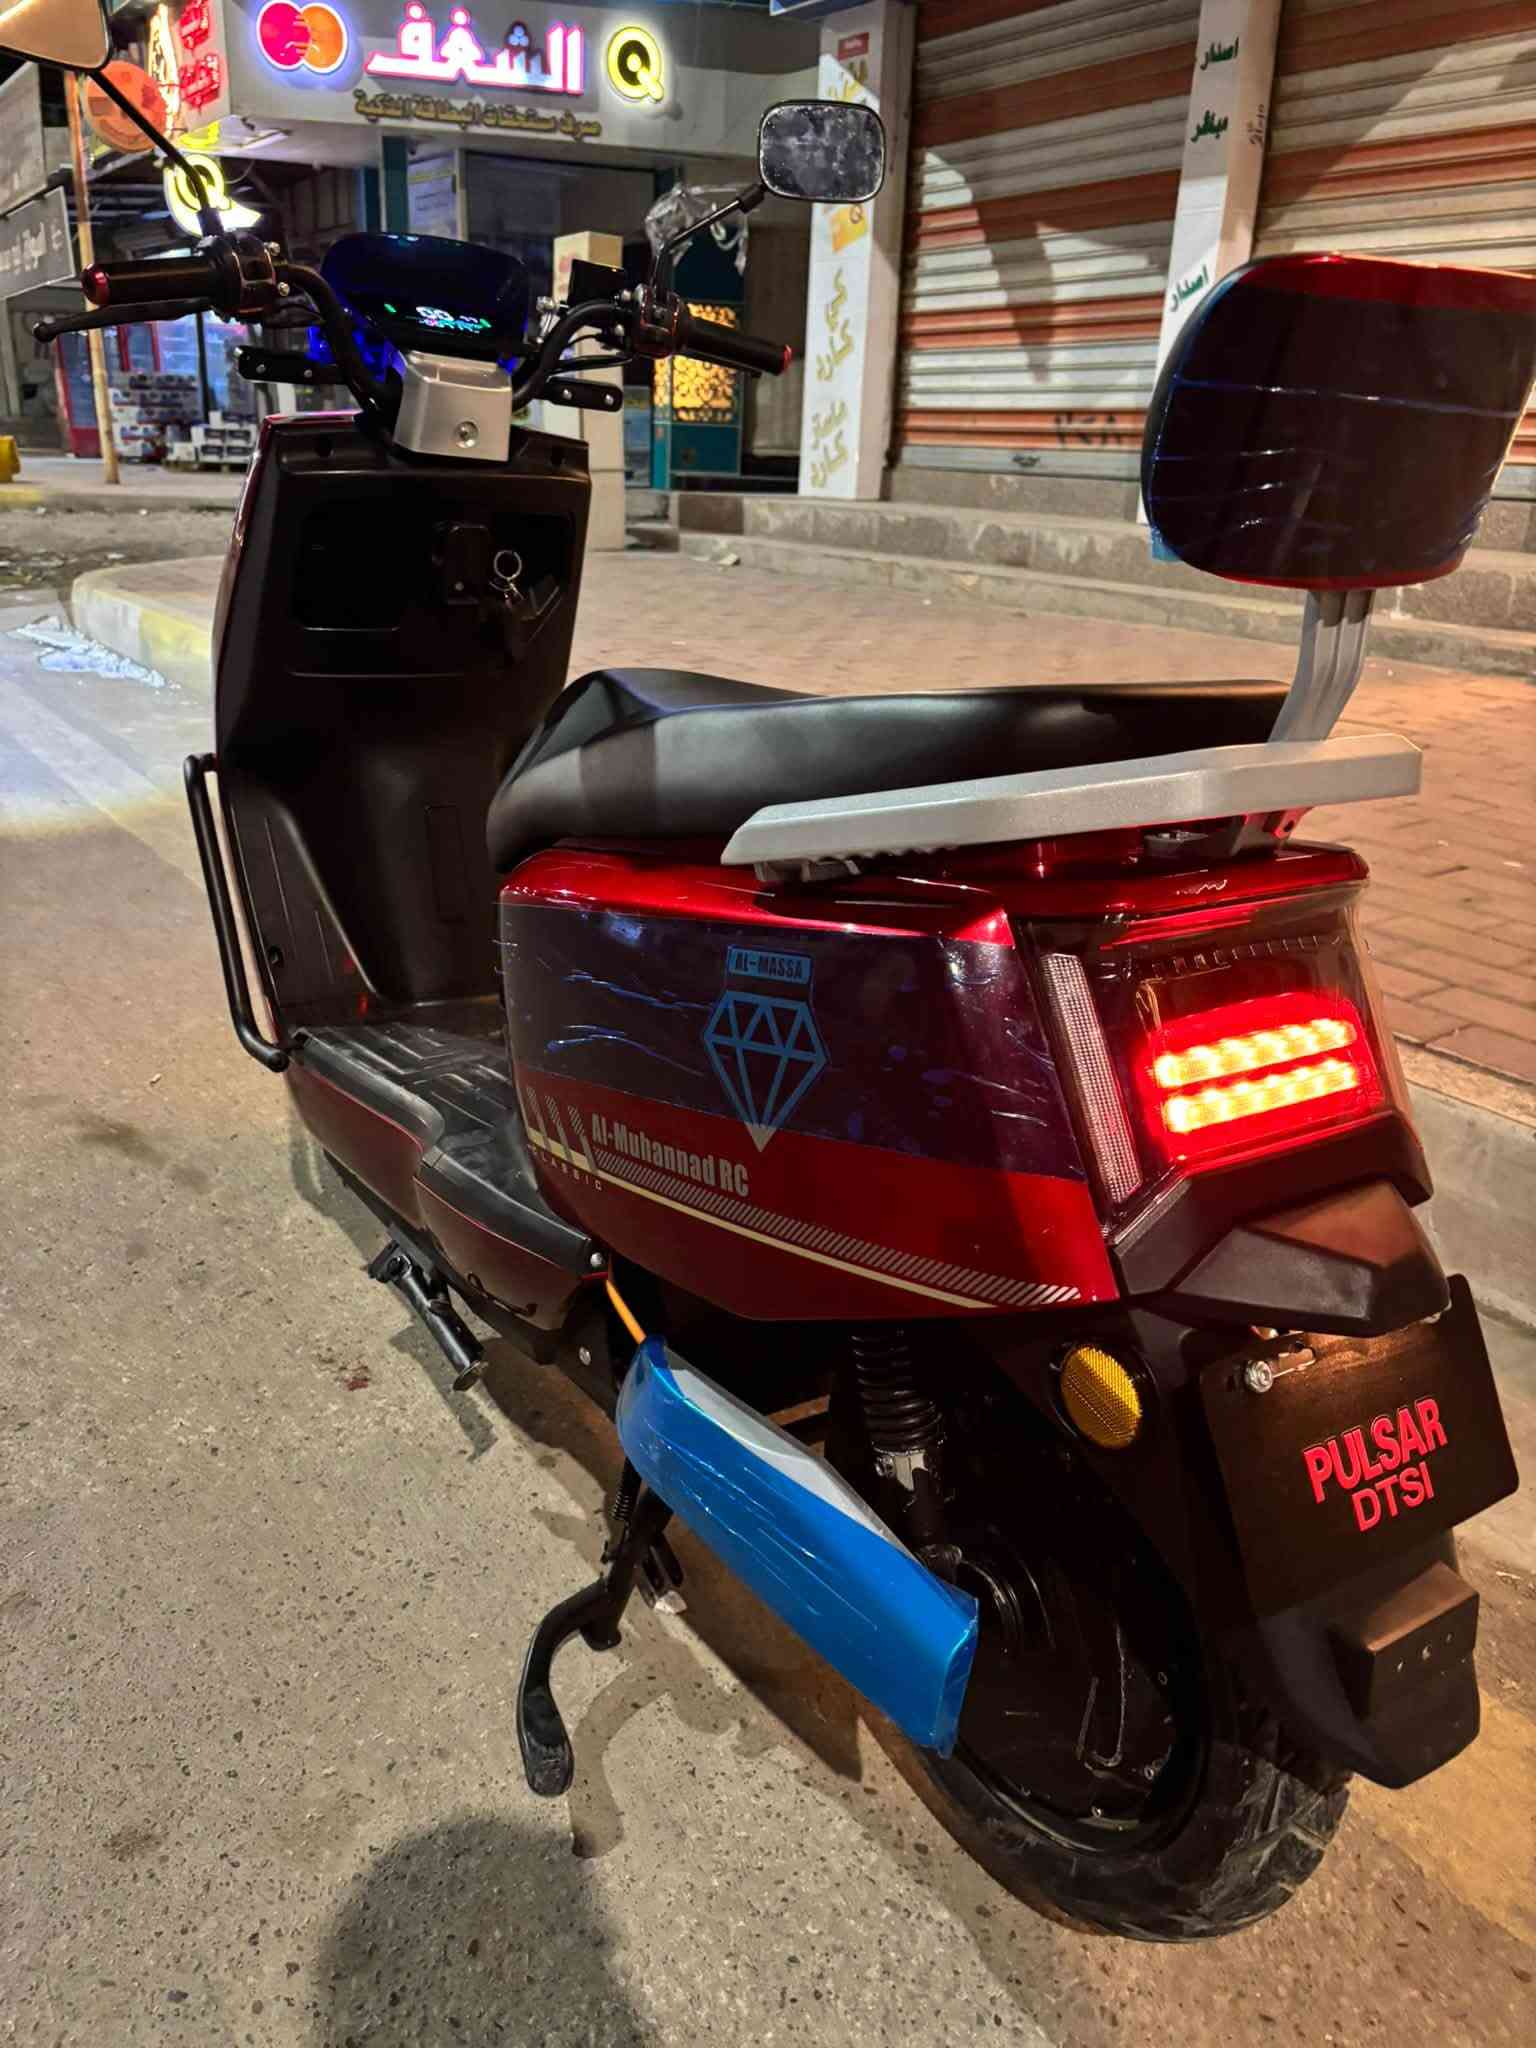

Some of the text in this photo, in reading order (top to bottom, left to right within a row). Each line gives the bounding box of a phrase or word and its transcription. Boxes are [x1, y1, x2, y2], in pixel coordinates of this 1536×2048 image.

[365, 1, 585, 96] الشغف
[607, 26, 665, 103] Q
[734, 950, 804, 980] AL-MASSA
[591, 1113, 749, 1197] Al-Muhannad RC
[1303, 1397, 1448, 1503] PULSAR
[1352, 1461, 1434, 1531] DTSI
